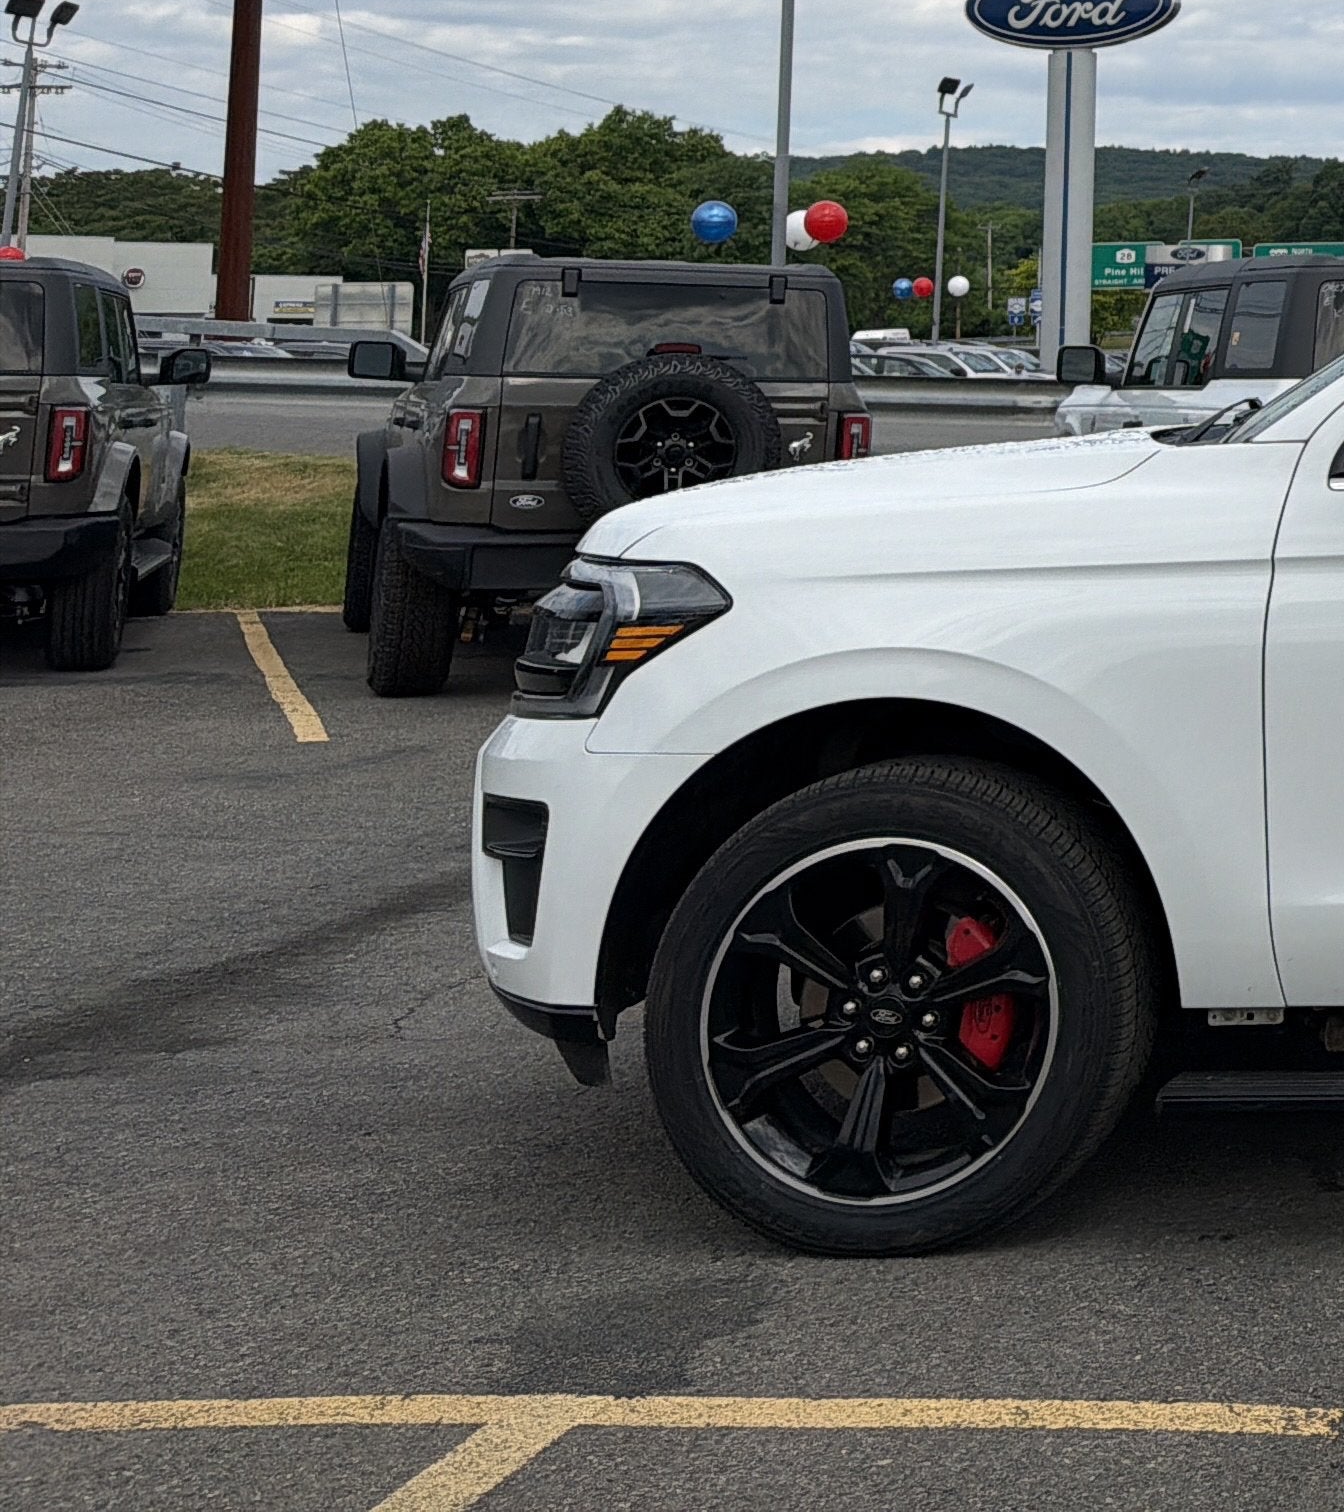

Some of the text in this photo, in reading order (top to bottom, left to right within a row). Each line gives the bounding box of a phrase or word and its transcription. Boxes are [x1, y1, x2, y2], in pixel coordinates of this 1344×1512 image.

[1119, 252, 1132, 261] 28
[1104, 267, 1144, 276] Pine Hil
